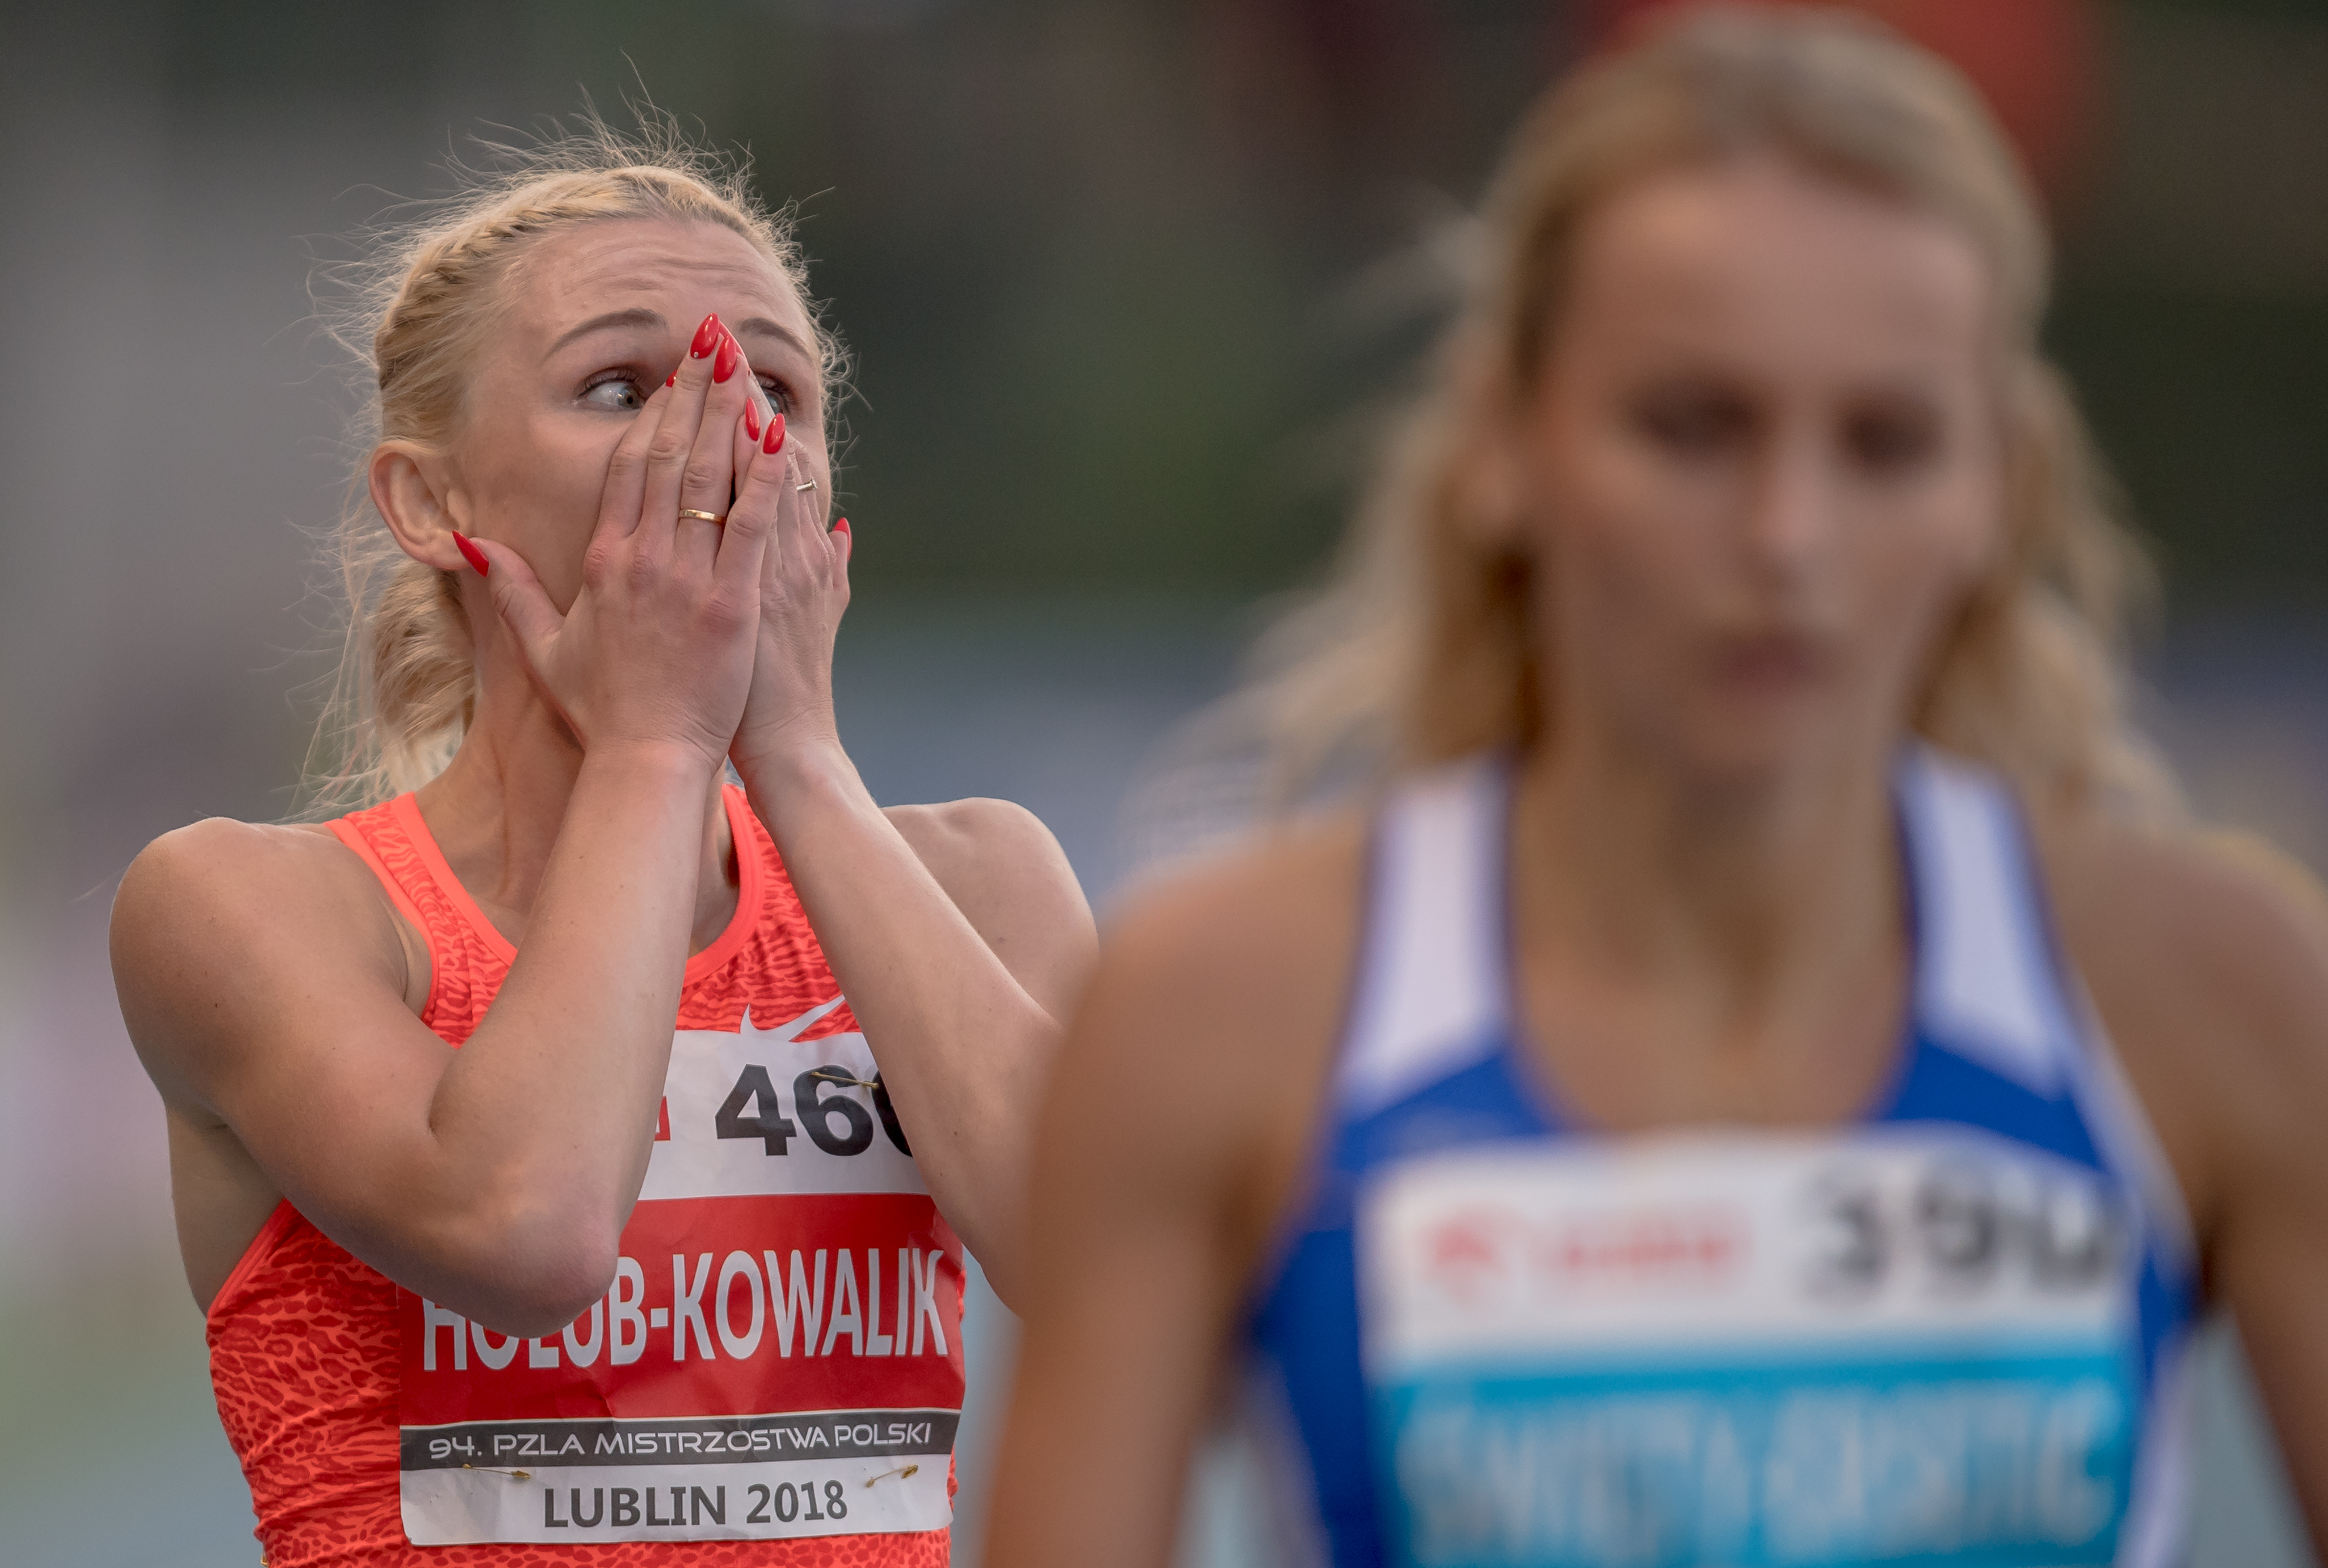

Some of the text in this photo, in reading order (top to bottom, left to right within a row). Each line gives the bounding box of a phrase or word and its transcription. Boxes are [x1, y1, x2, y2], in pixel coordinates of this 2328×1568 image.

[422, 1247, 948, 1371] HUB-KOWALIK
[428, 1422, 932, 1459] 94. PZLA MISTRZOSTWA POLSKI
[544, 1480, 848, 1528] LUBLIN 2018
